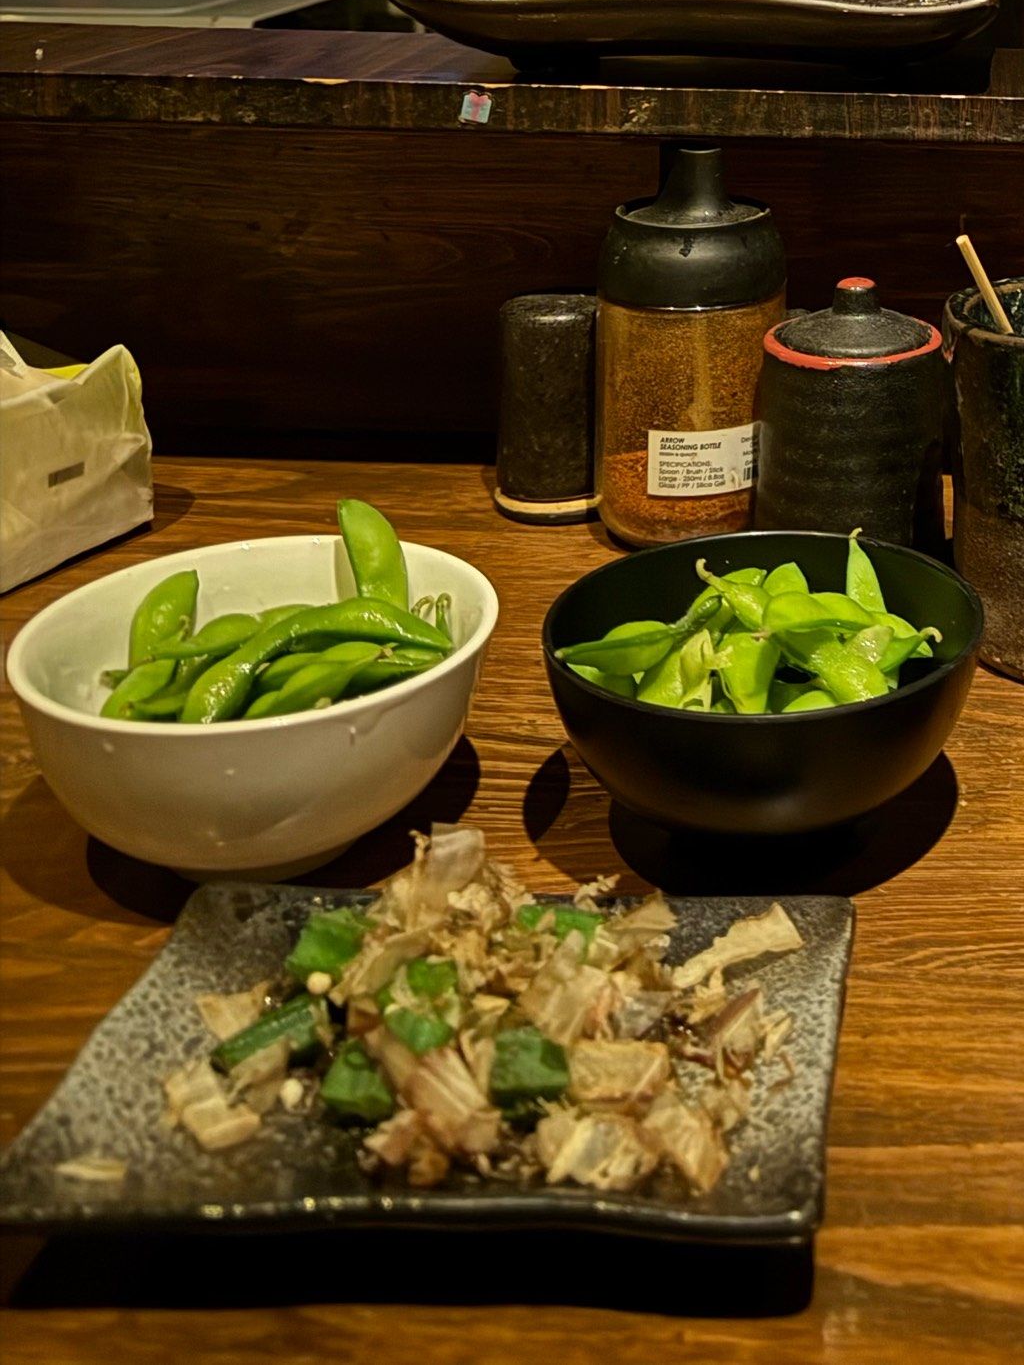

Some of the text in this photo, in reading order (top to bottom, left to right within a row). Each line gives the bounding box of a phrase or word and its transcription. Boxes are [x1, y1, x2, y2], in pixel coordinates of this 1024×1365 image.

[660, 442, 722, 451] SEASONING BOTTLE
[659, 460, 712, 468] SPECIFICATIONS:
